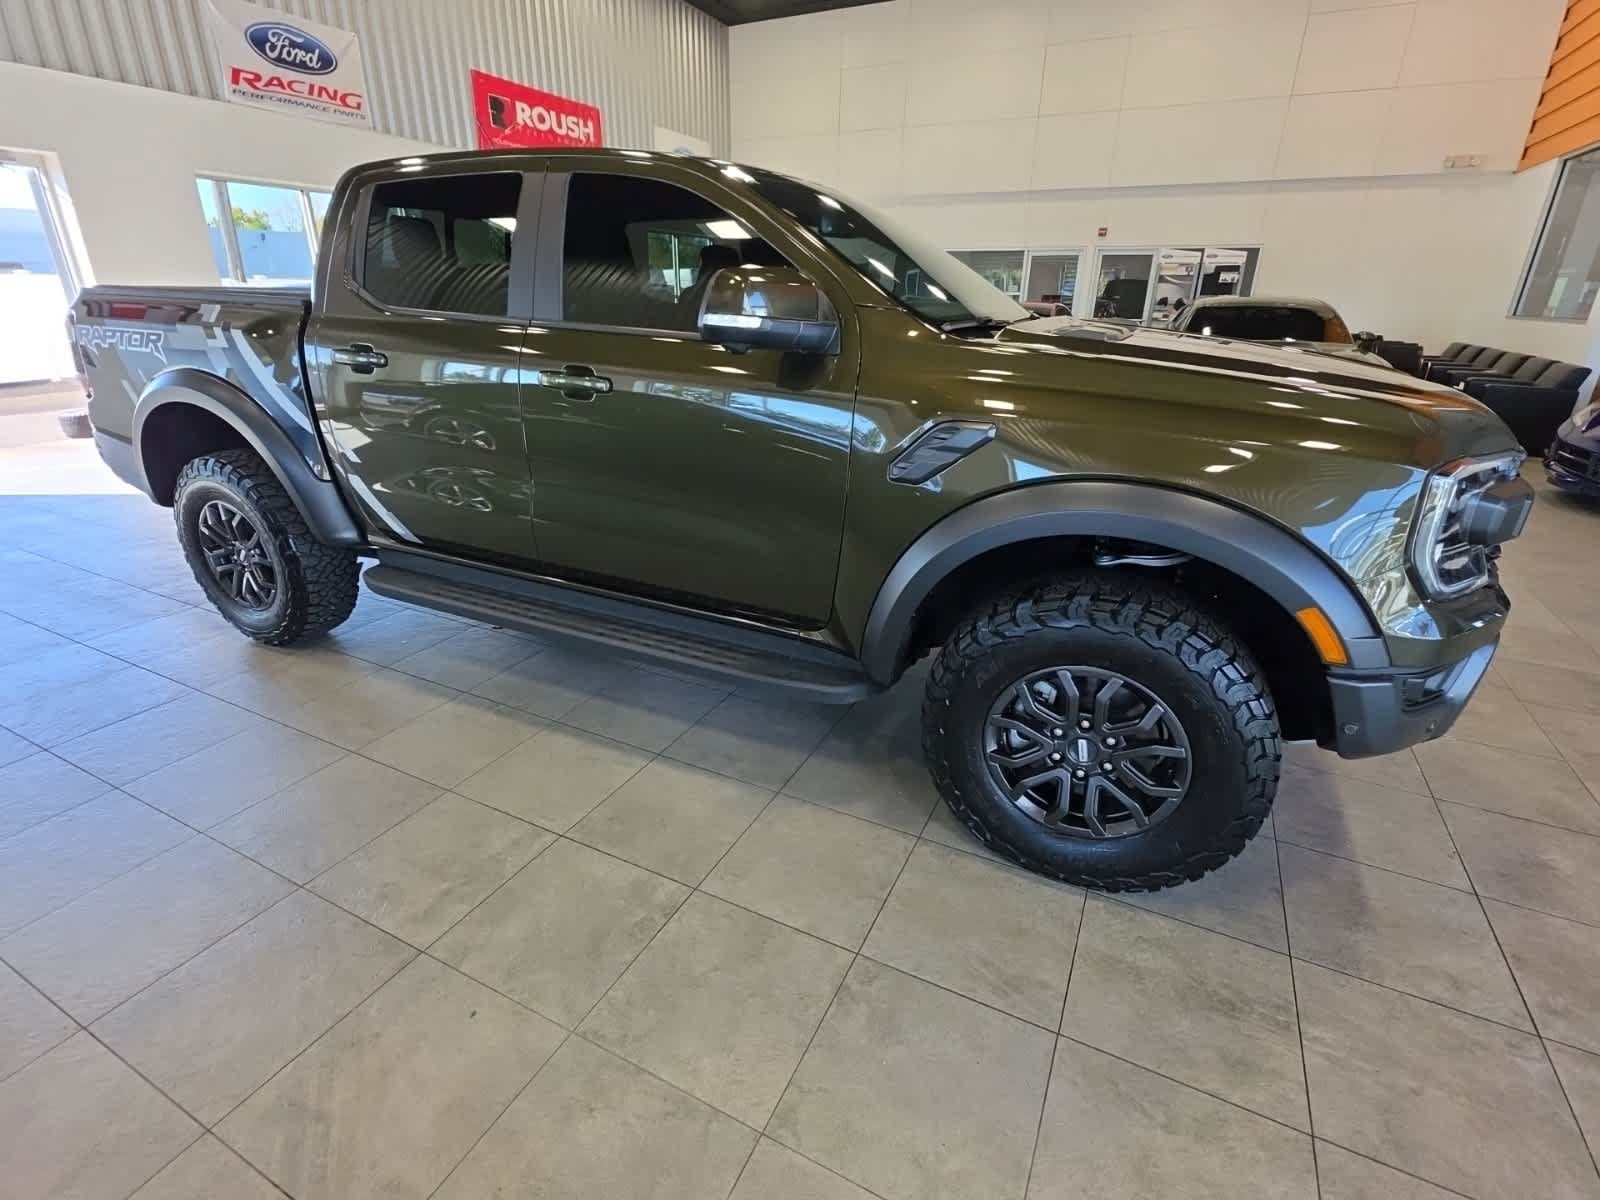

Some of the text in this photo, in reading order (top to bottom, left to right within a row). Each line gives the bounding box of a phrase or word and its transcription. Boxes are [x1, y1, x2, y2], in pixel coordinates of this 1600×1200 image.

[265, 29, 322, 70] Ford
[230, 67, 363, 111] RACING
[232, 88, 367, 121] PERFORMANCE PARTS
[514, 100, 595, 143] ROUSH
[76, 324, 168, 365] RAPTOR
